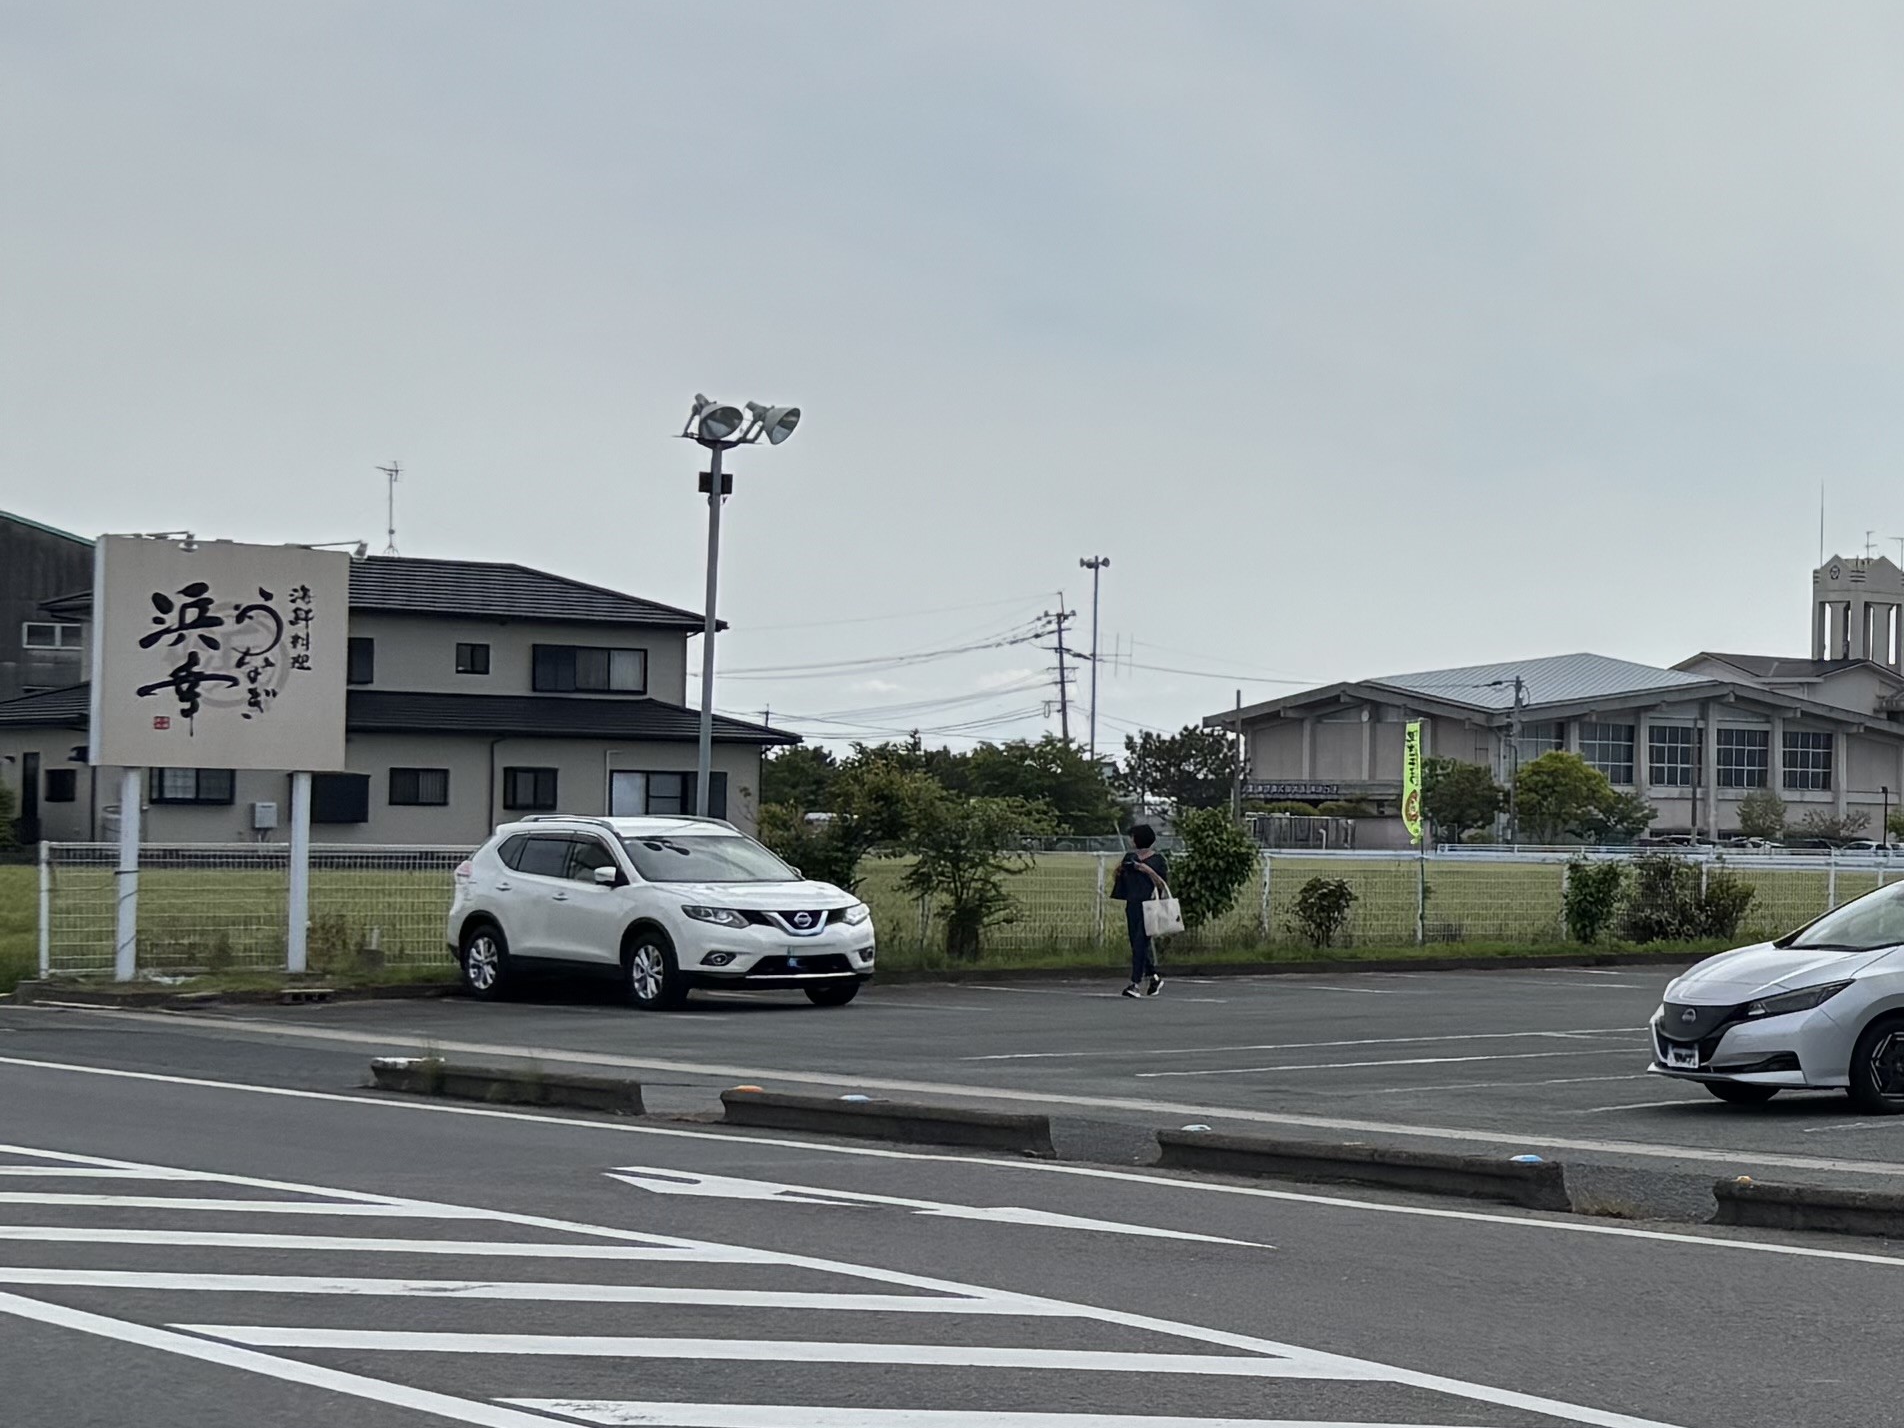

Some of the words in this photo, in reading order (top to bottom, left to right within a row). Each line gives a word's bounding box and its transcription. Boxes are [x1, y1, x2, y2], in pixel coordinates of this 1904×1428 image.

[136, 581, 240, 737] 浜幸
[231, 586, 284, 719] うなぎ
